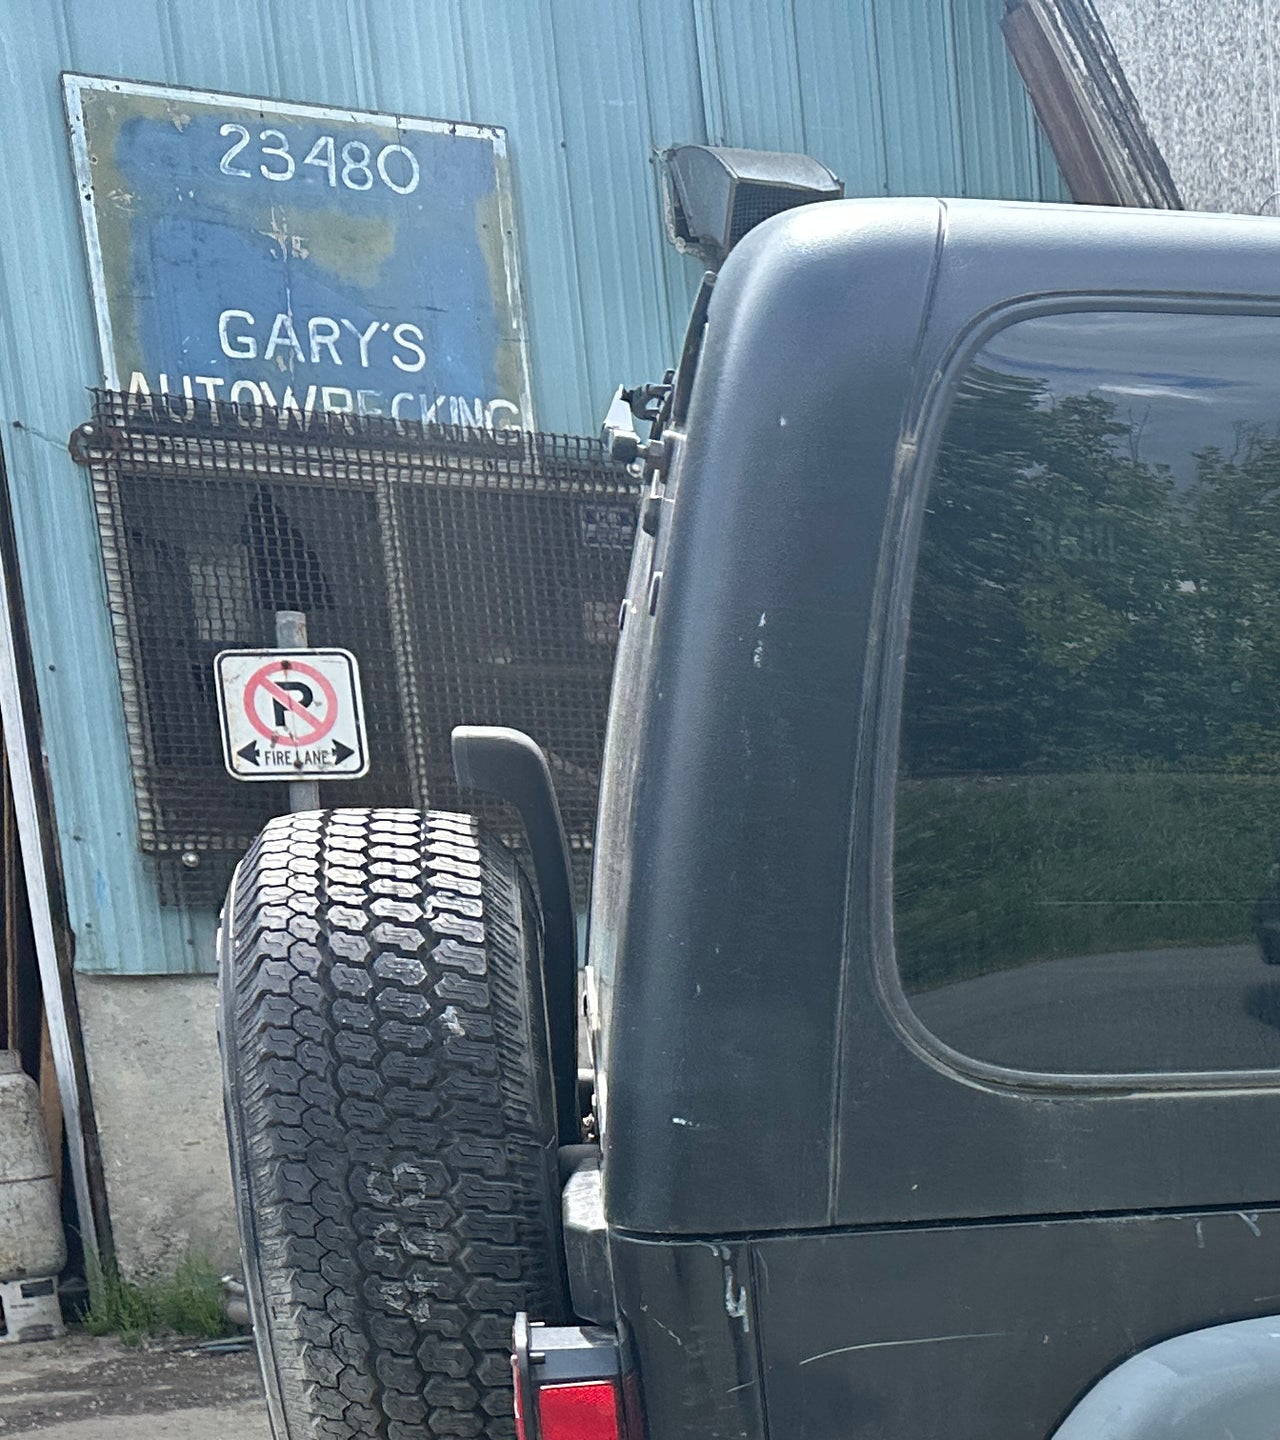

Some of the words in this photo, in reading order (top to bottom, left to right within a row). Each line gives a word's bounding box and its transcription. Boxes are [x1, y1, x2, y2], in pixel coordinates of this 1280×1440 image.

[219, 122, 420, 195] 23480
[218, 309, 426, 373] GARY'S
[264, 750, 292, 766] FIRE
